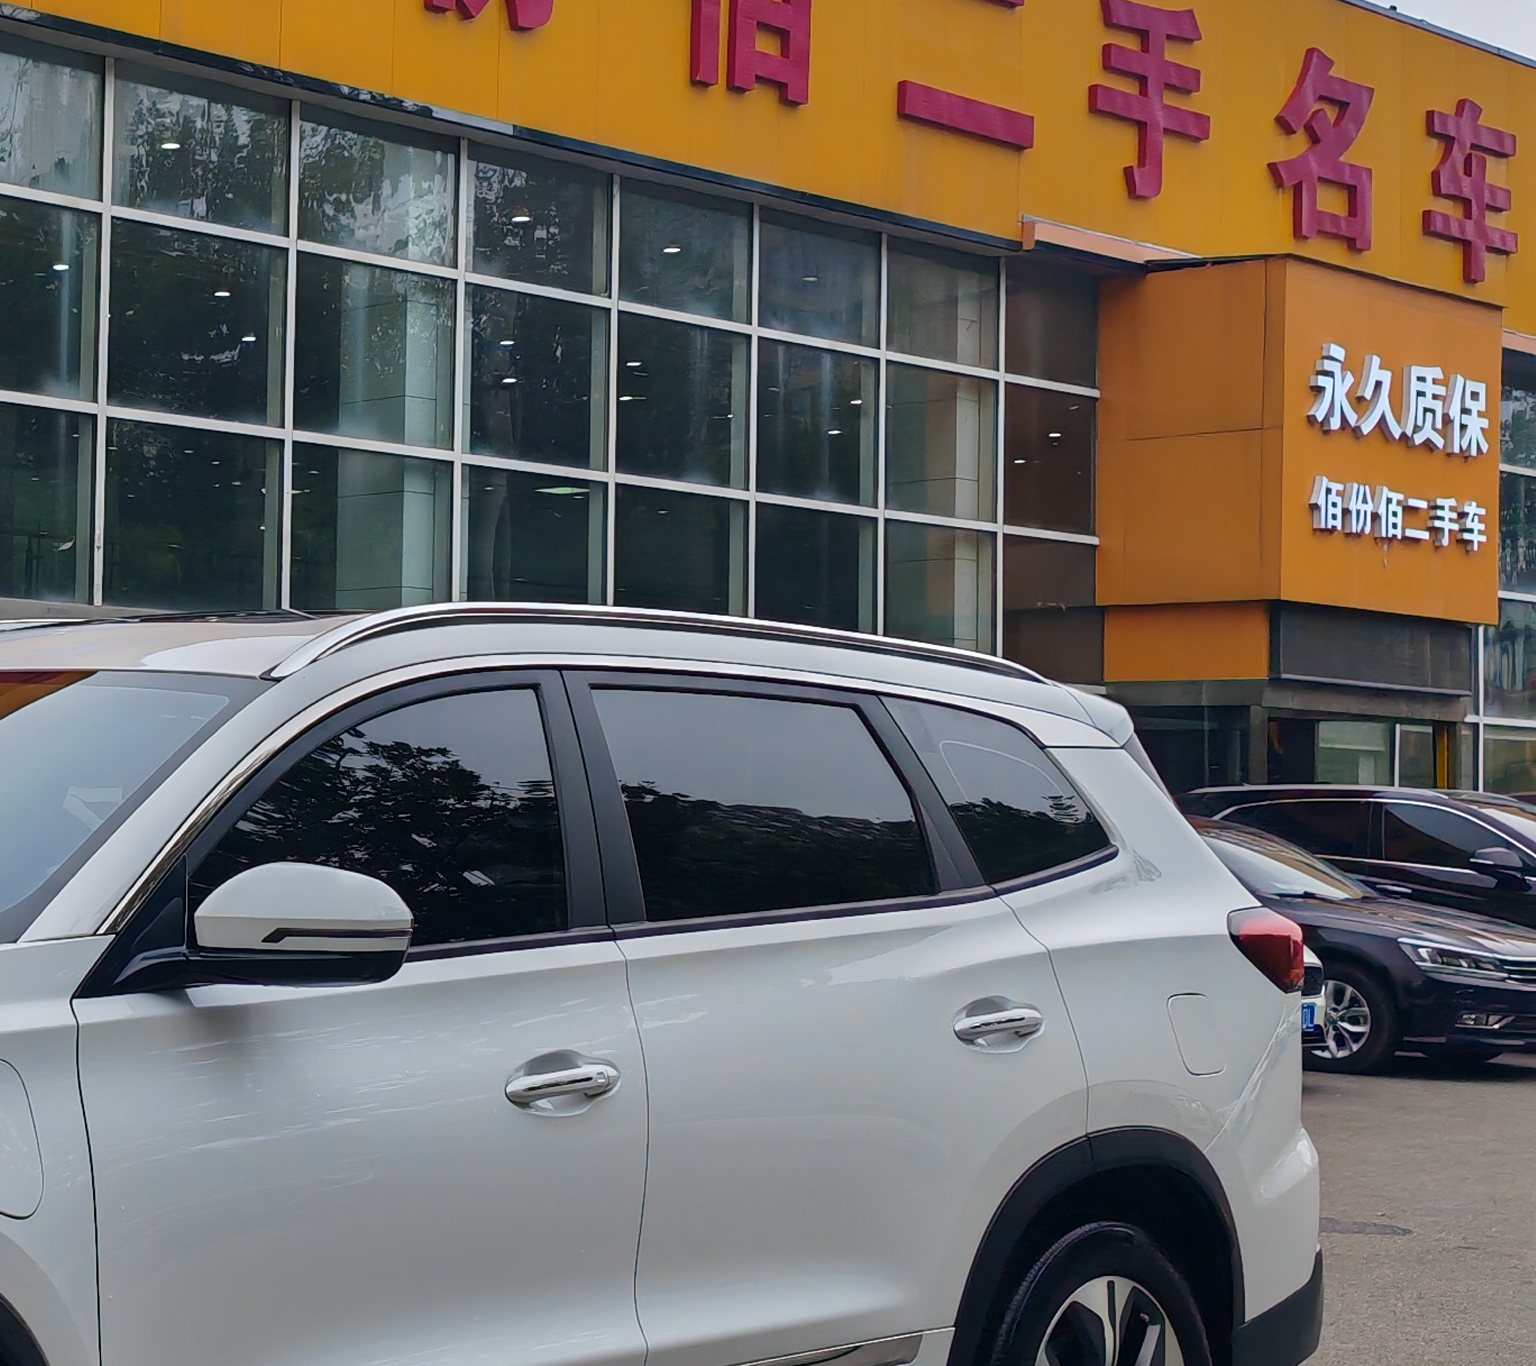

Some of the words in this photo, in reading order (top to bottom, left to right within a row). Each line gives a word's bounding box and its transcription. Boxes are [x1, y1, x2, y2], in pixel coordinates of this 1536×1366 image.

[1306, 343, 1490, 458] 永久质保
[1308, 475, 1488, 552] 佰份佰二手车
